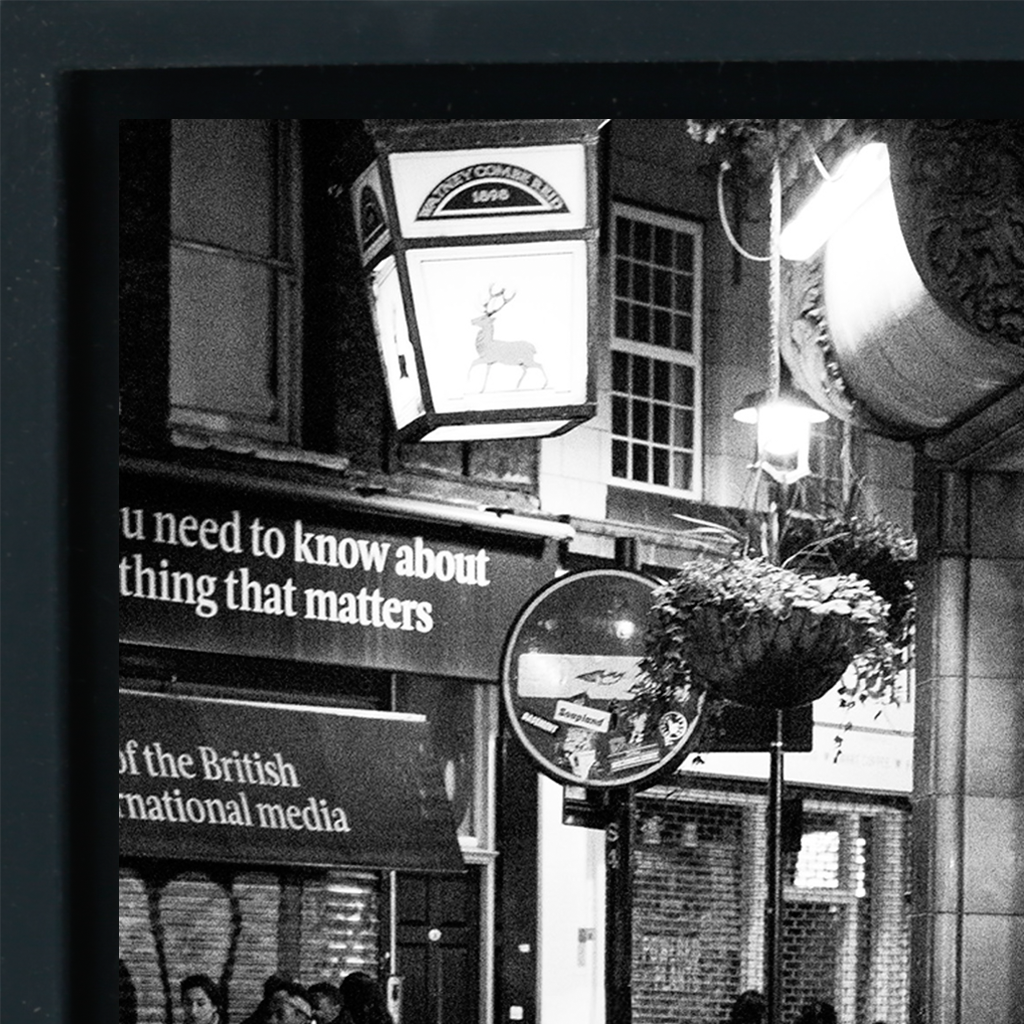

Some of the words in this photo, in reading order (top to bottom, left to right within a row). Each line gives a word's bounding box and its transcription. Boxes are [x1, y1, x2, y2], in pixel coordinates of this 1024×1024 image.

[153, 510, 243, 552] need
[250, 517, 286, 559] to
[294, 519, 391, 573] know
[394, 536, 492, 587] about
[118, 553, 219, 618] thing
[224, 567, 298, 618] that
[304, 585, 434, 633] matters
[142, 742, 197, 780] the
[199, 744, 302, 788] British
[255, 796, 352, 834] media
